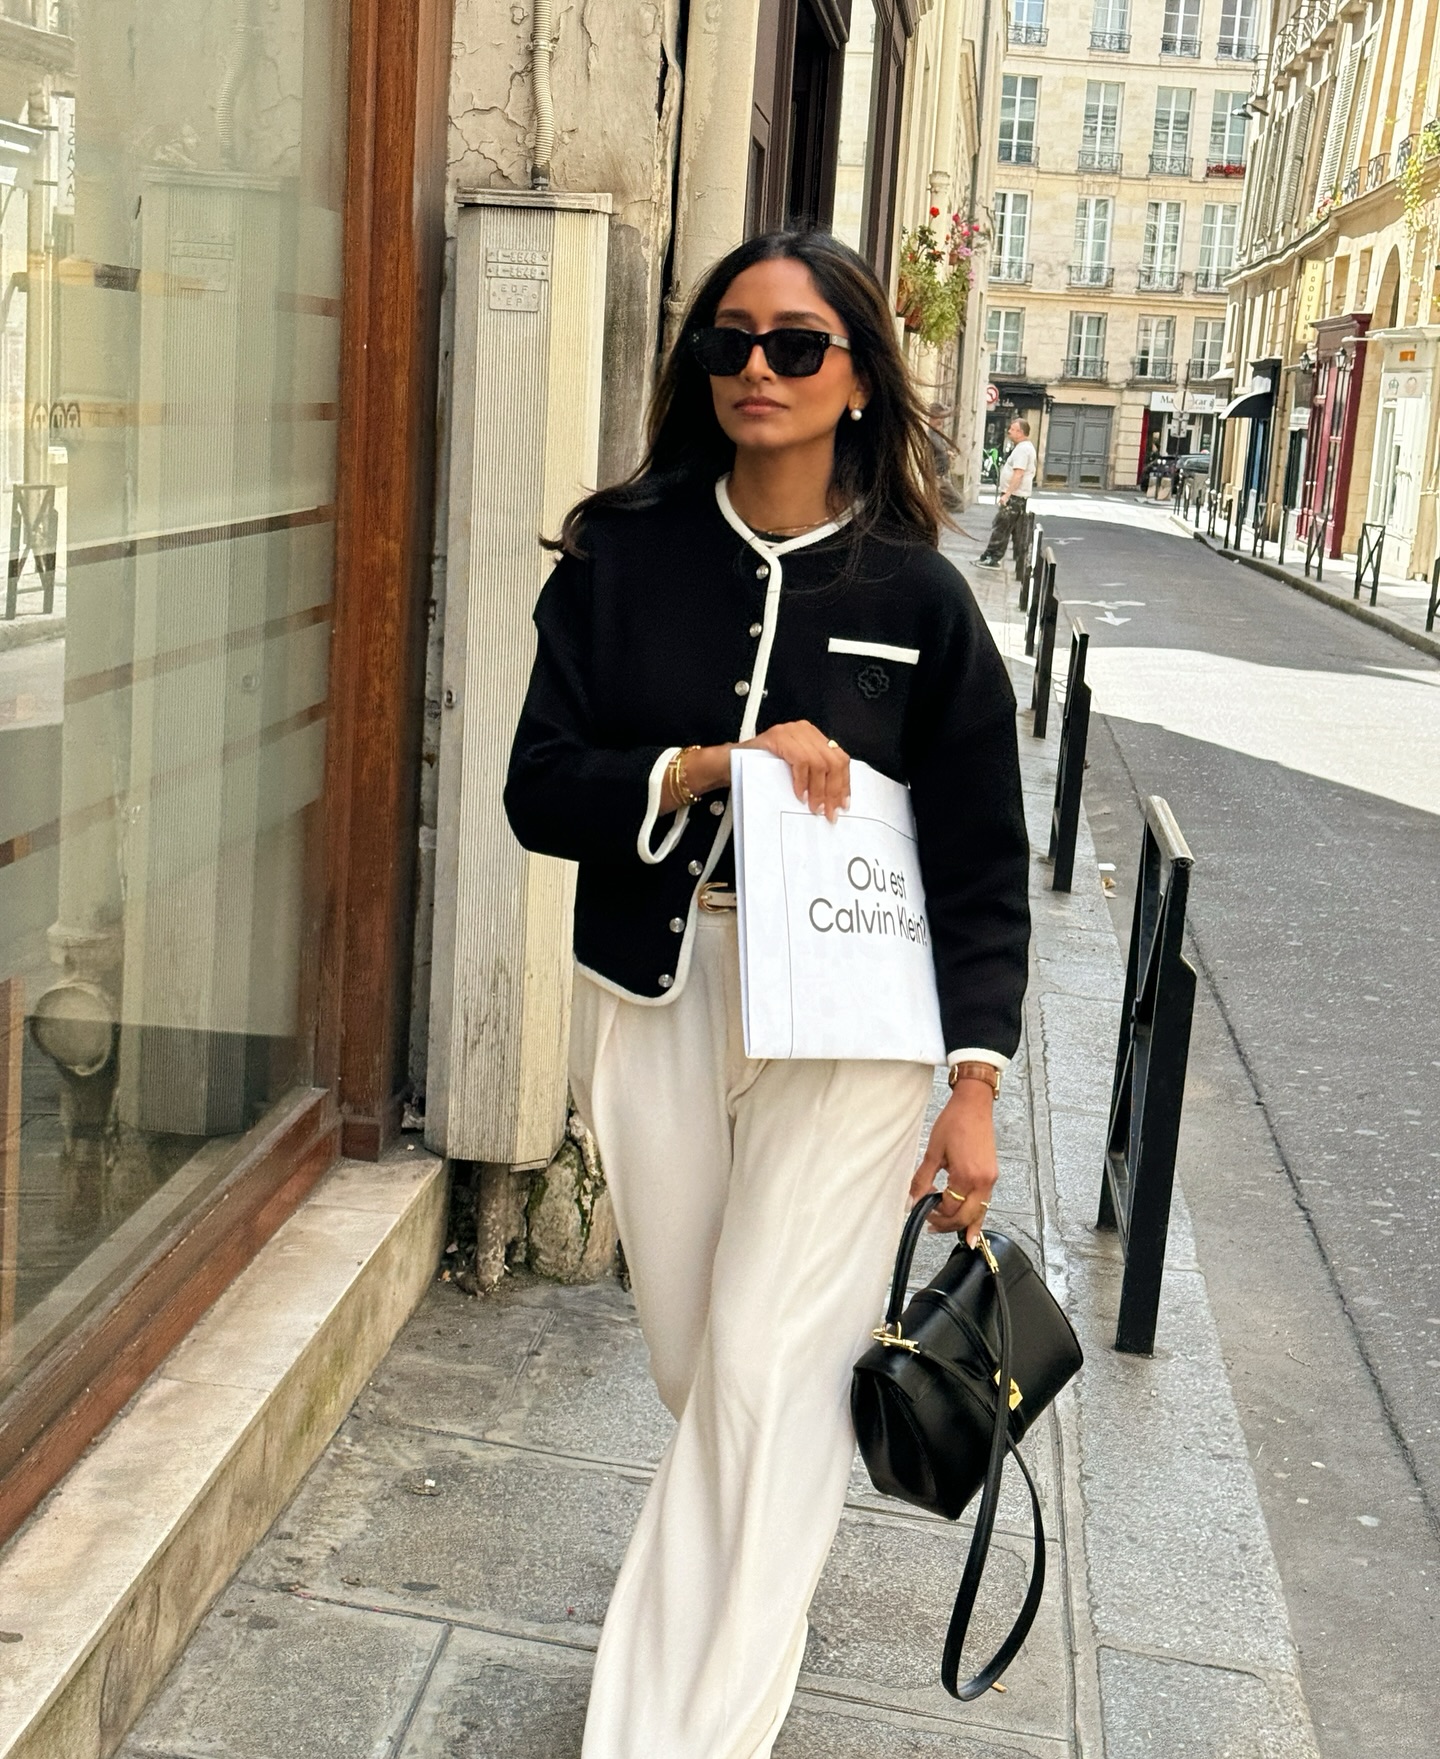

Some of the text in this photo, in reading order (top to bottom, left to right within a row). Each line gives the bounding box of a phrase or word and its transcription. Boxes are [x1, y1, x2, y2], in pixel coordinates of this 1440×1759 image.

[847, 856, 906, 900] Où est
[808, 897, 928, 947] Calvin Klein?
